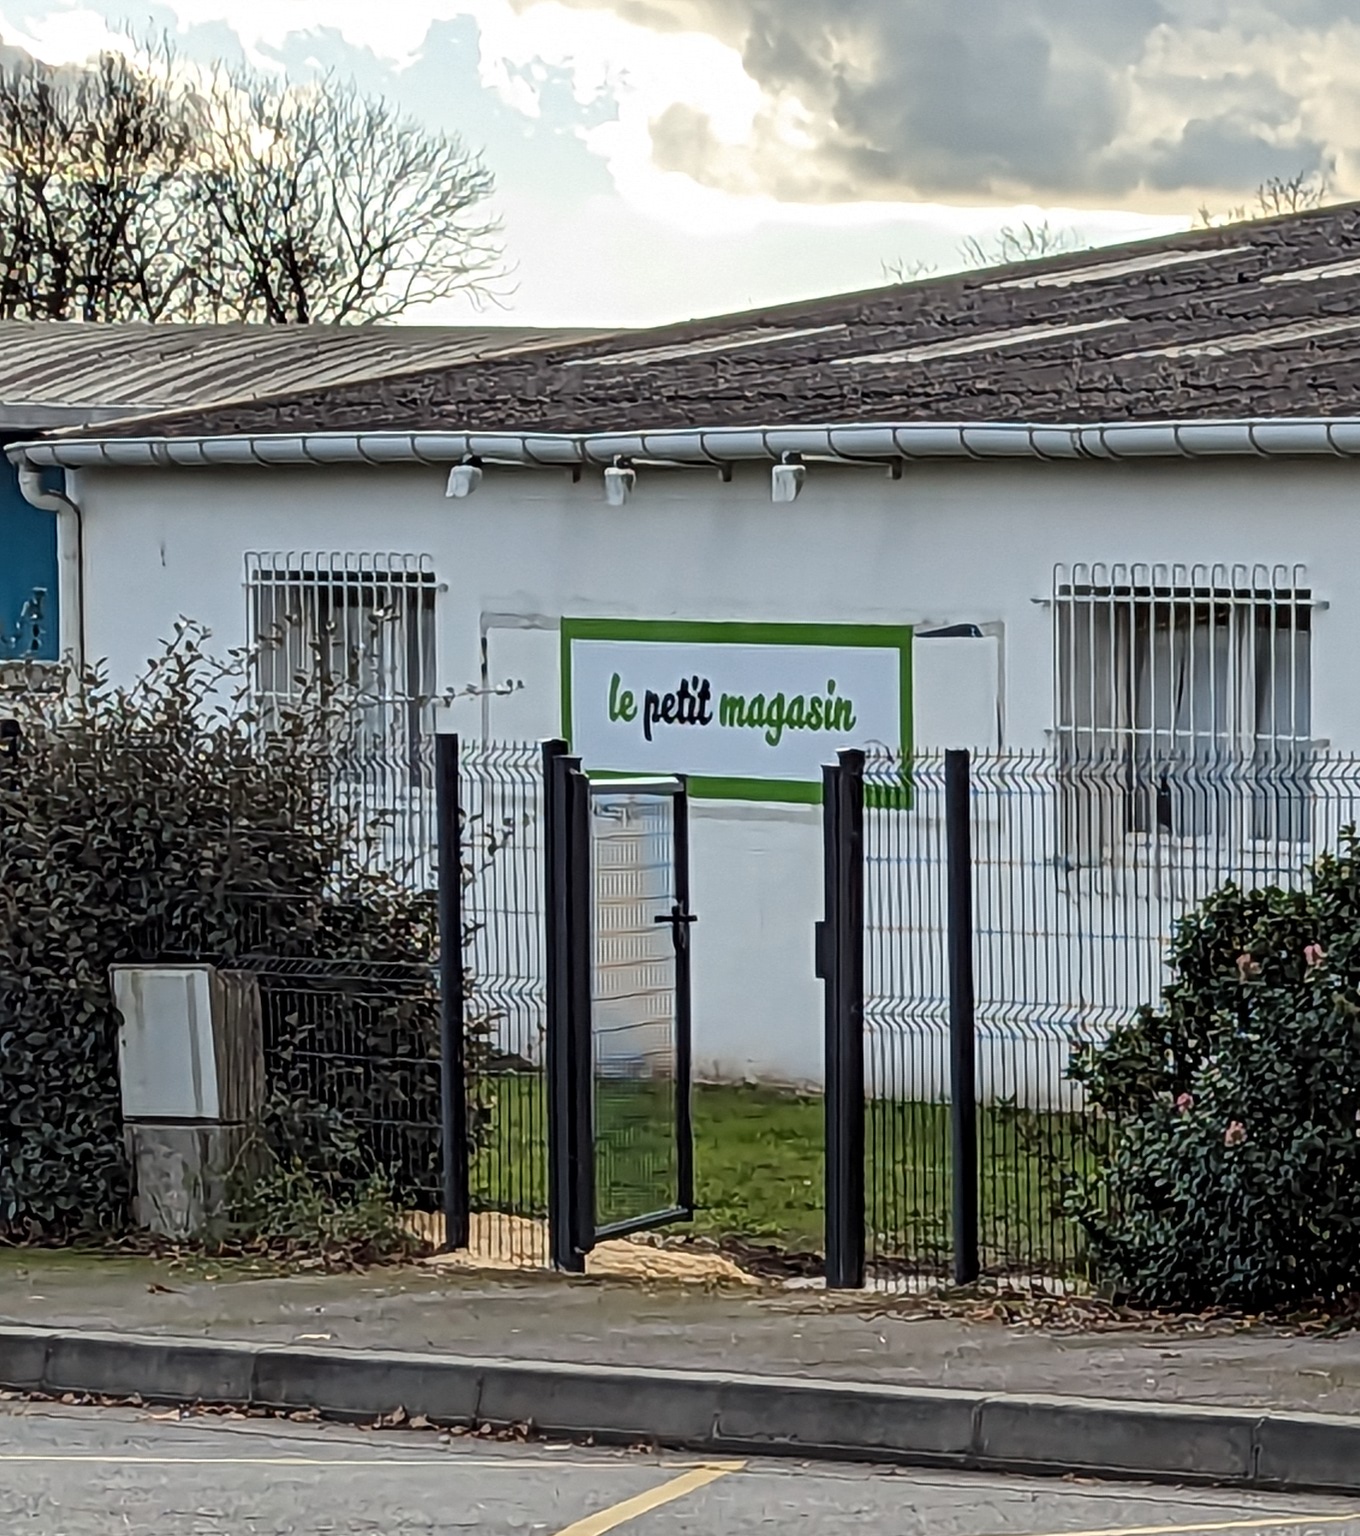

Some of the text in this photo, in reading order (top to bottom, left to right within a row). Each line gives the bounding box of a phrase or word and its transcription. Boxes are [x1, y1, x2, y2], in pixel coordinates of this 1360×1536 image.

[608, 672, 857, 746] le petit magasin
